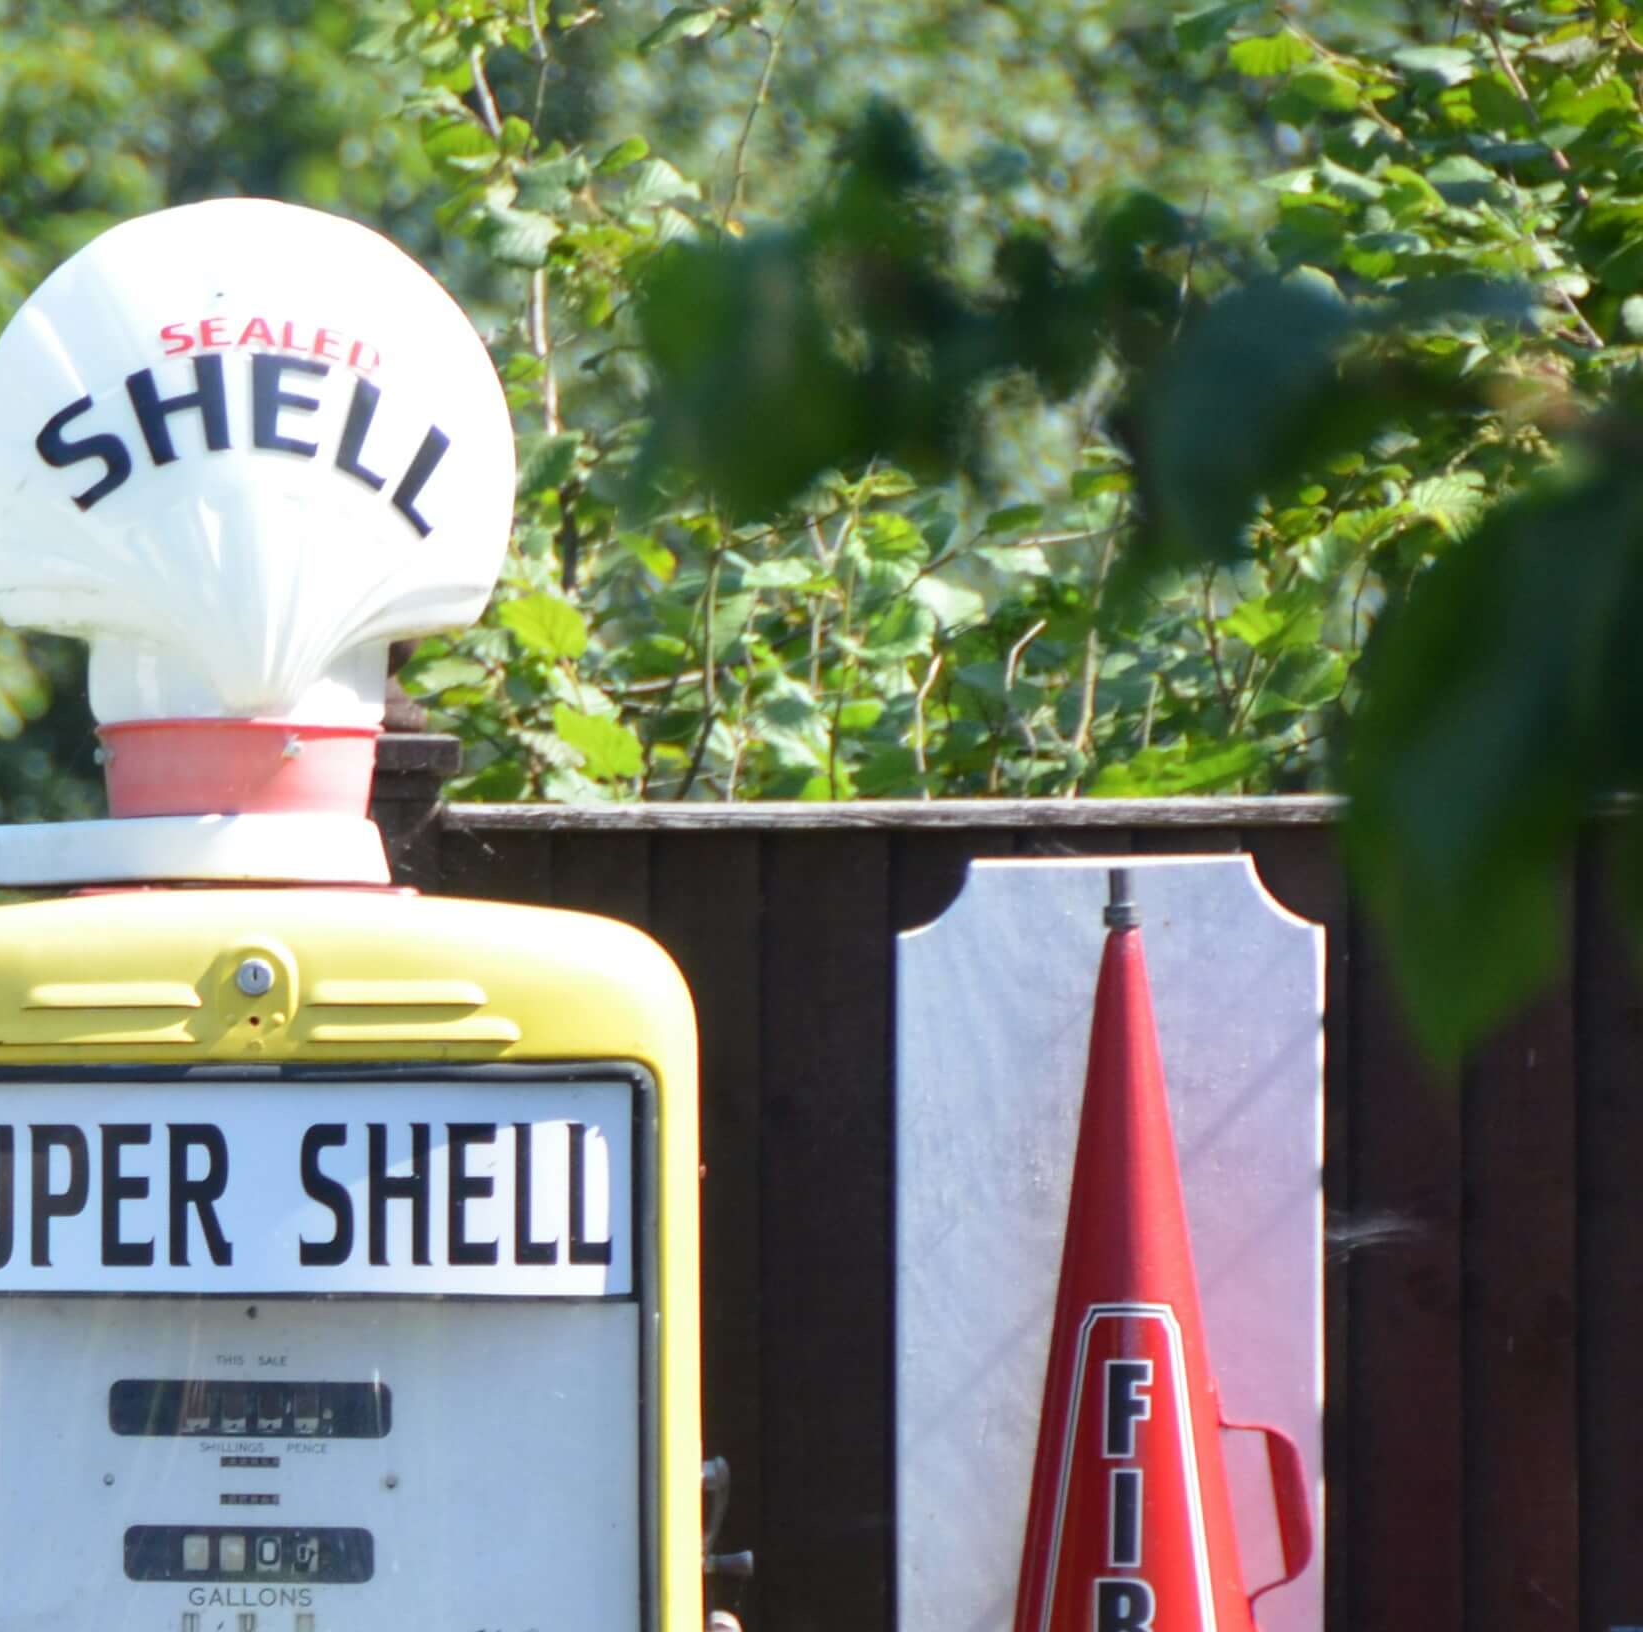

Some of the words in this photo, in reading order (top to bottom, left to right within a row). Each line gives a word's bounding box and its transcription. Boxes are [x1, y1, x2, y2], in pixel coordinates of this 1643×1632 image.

[160, 316, 381, 371] SEALED
[35, 352, 451, 540] SHELL
[298, 1121, 614, 1268] SHELL
[215, 1355, 245, 1367] THIS
[258, 1355, 288, 1367] SALE
[199, 1442, 265, 1454] SHILLINGS
[285, 1443, 328, 1454] PENCE
[188, 1587, 313, 1607] GALLONS
